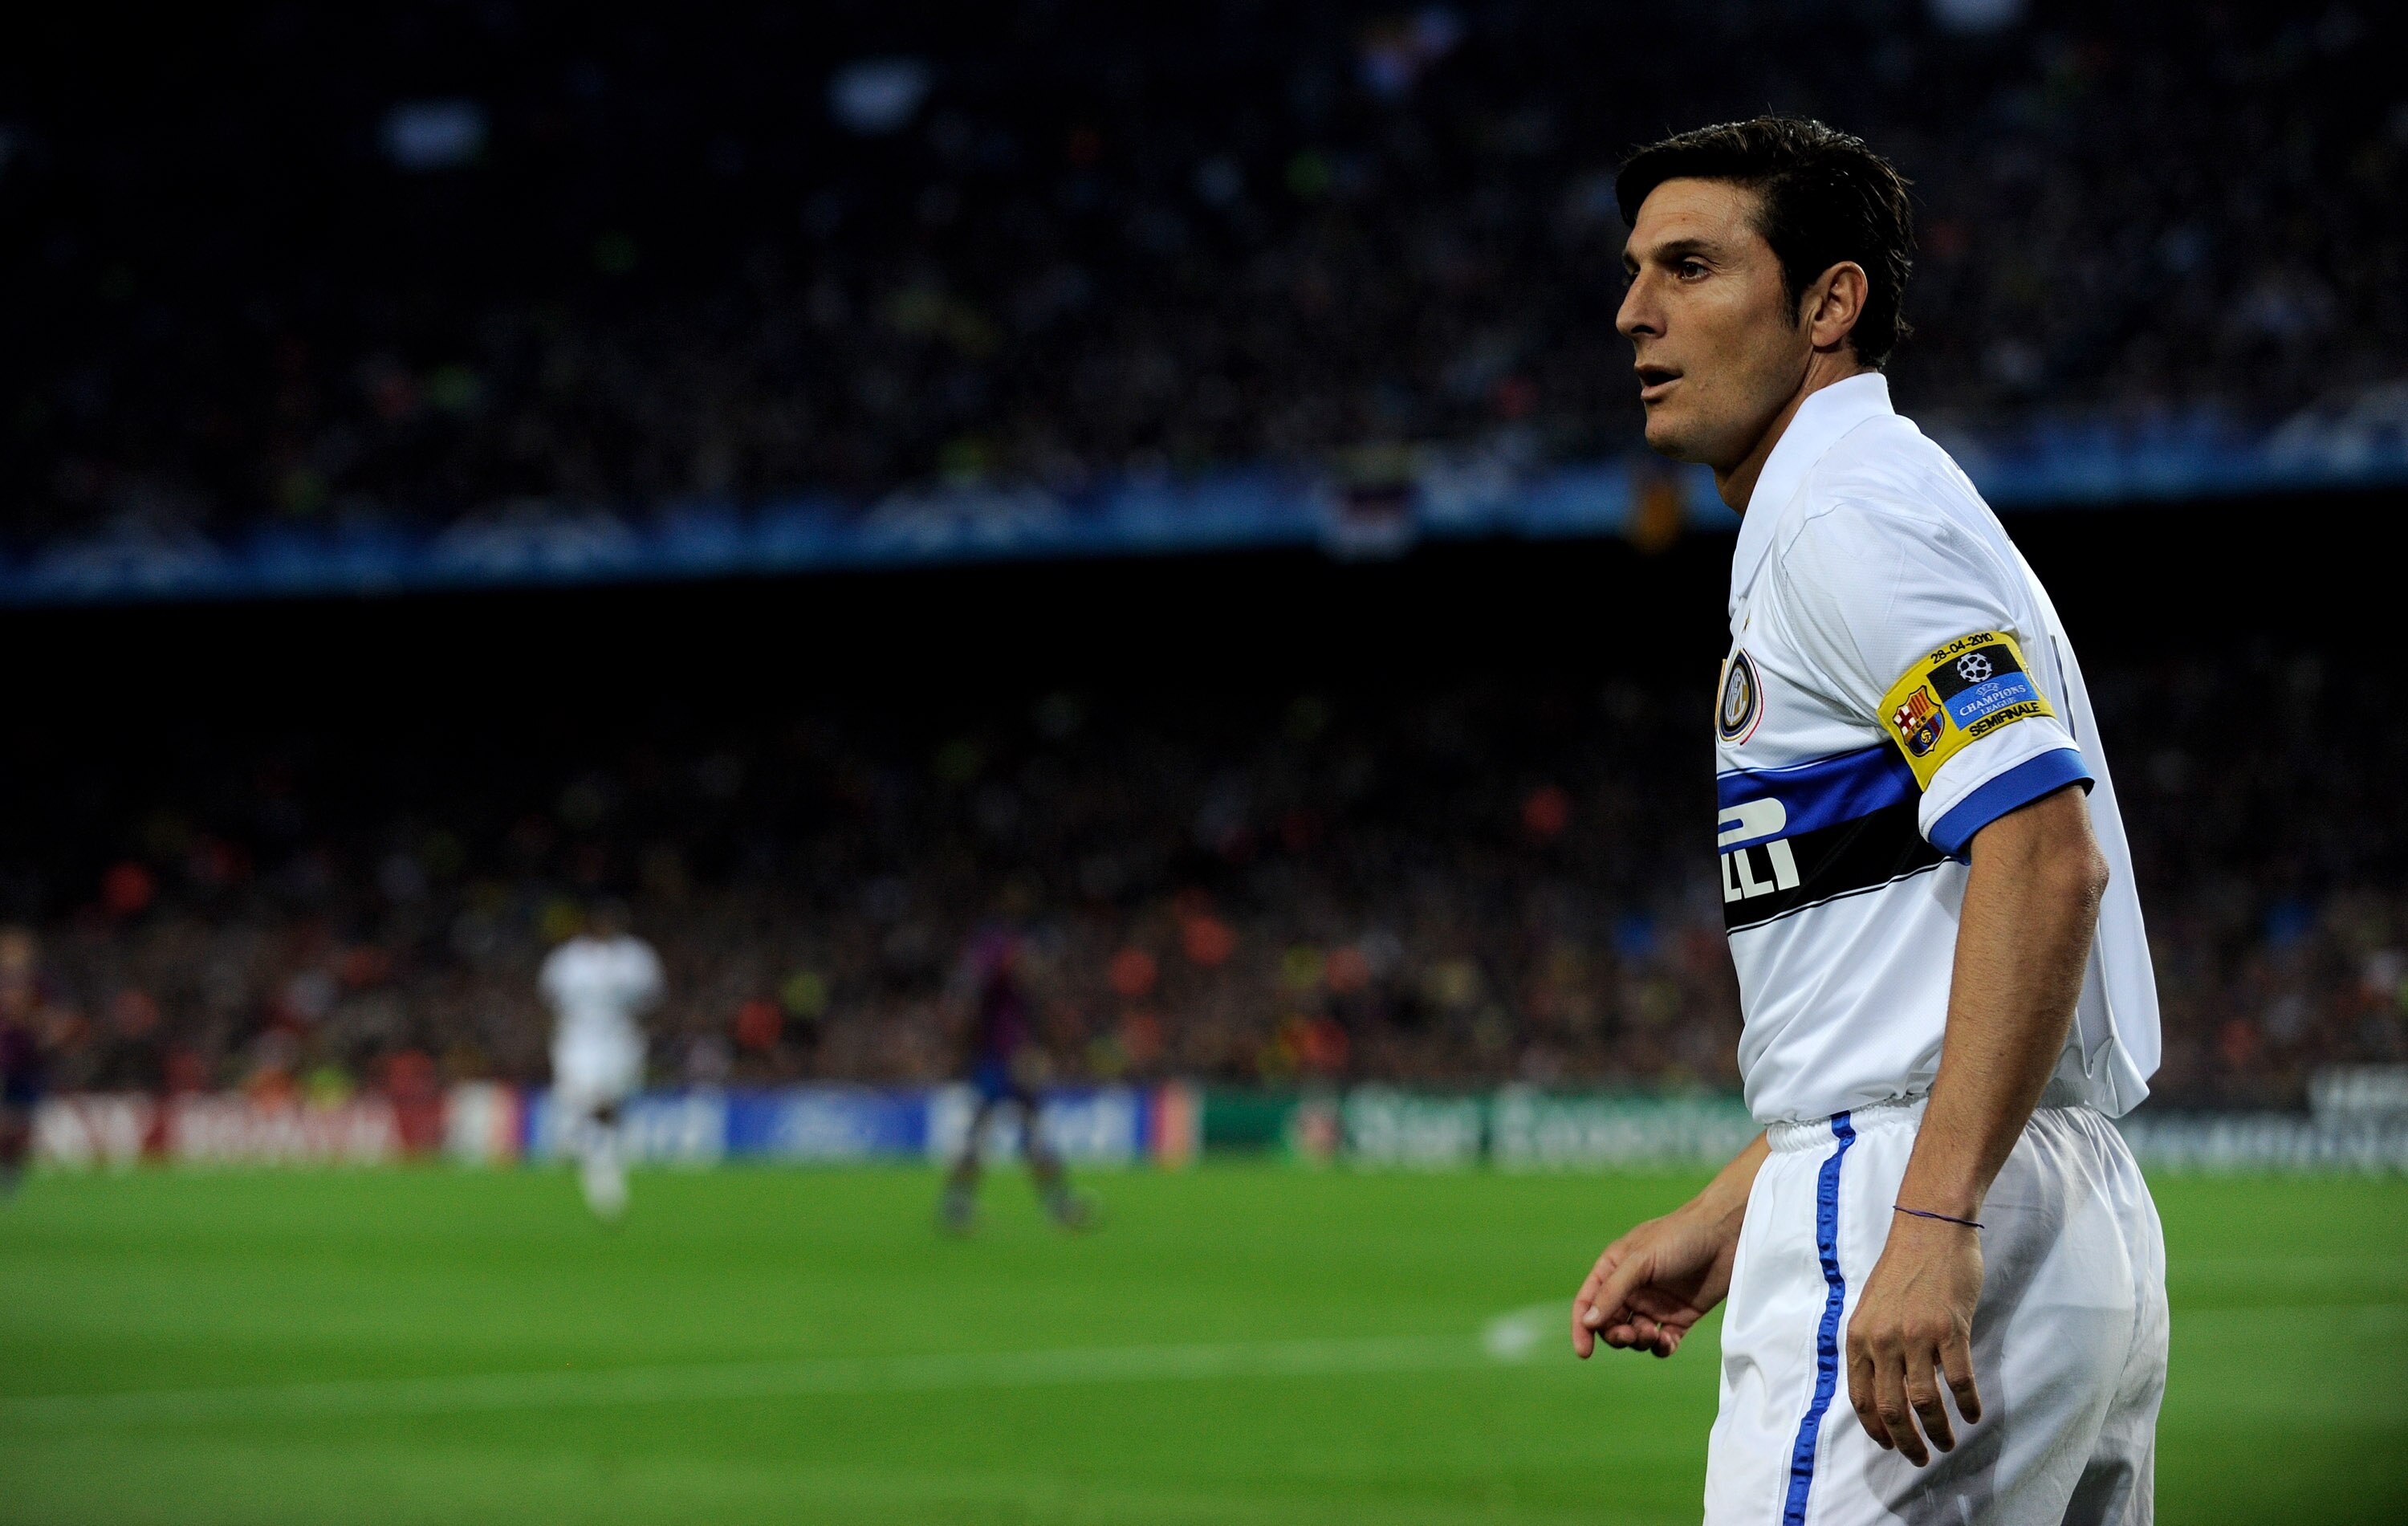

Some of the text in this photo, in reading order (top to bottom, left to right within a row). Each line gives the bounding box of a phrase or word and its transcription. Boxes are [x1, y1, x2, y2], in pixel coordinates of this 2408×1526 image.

[1930, 633, 1994, 665] 28-04-2010
[1959, 685, 2027, 716] CHAMPIONS
[1980, 697, 2016, 714] LEAGUE
[1969, 702, 2040, 737] SEMIFINALE
